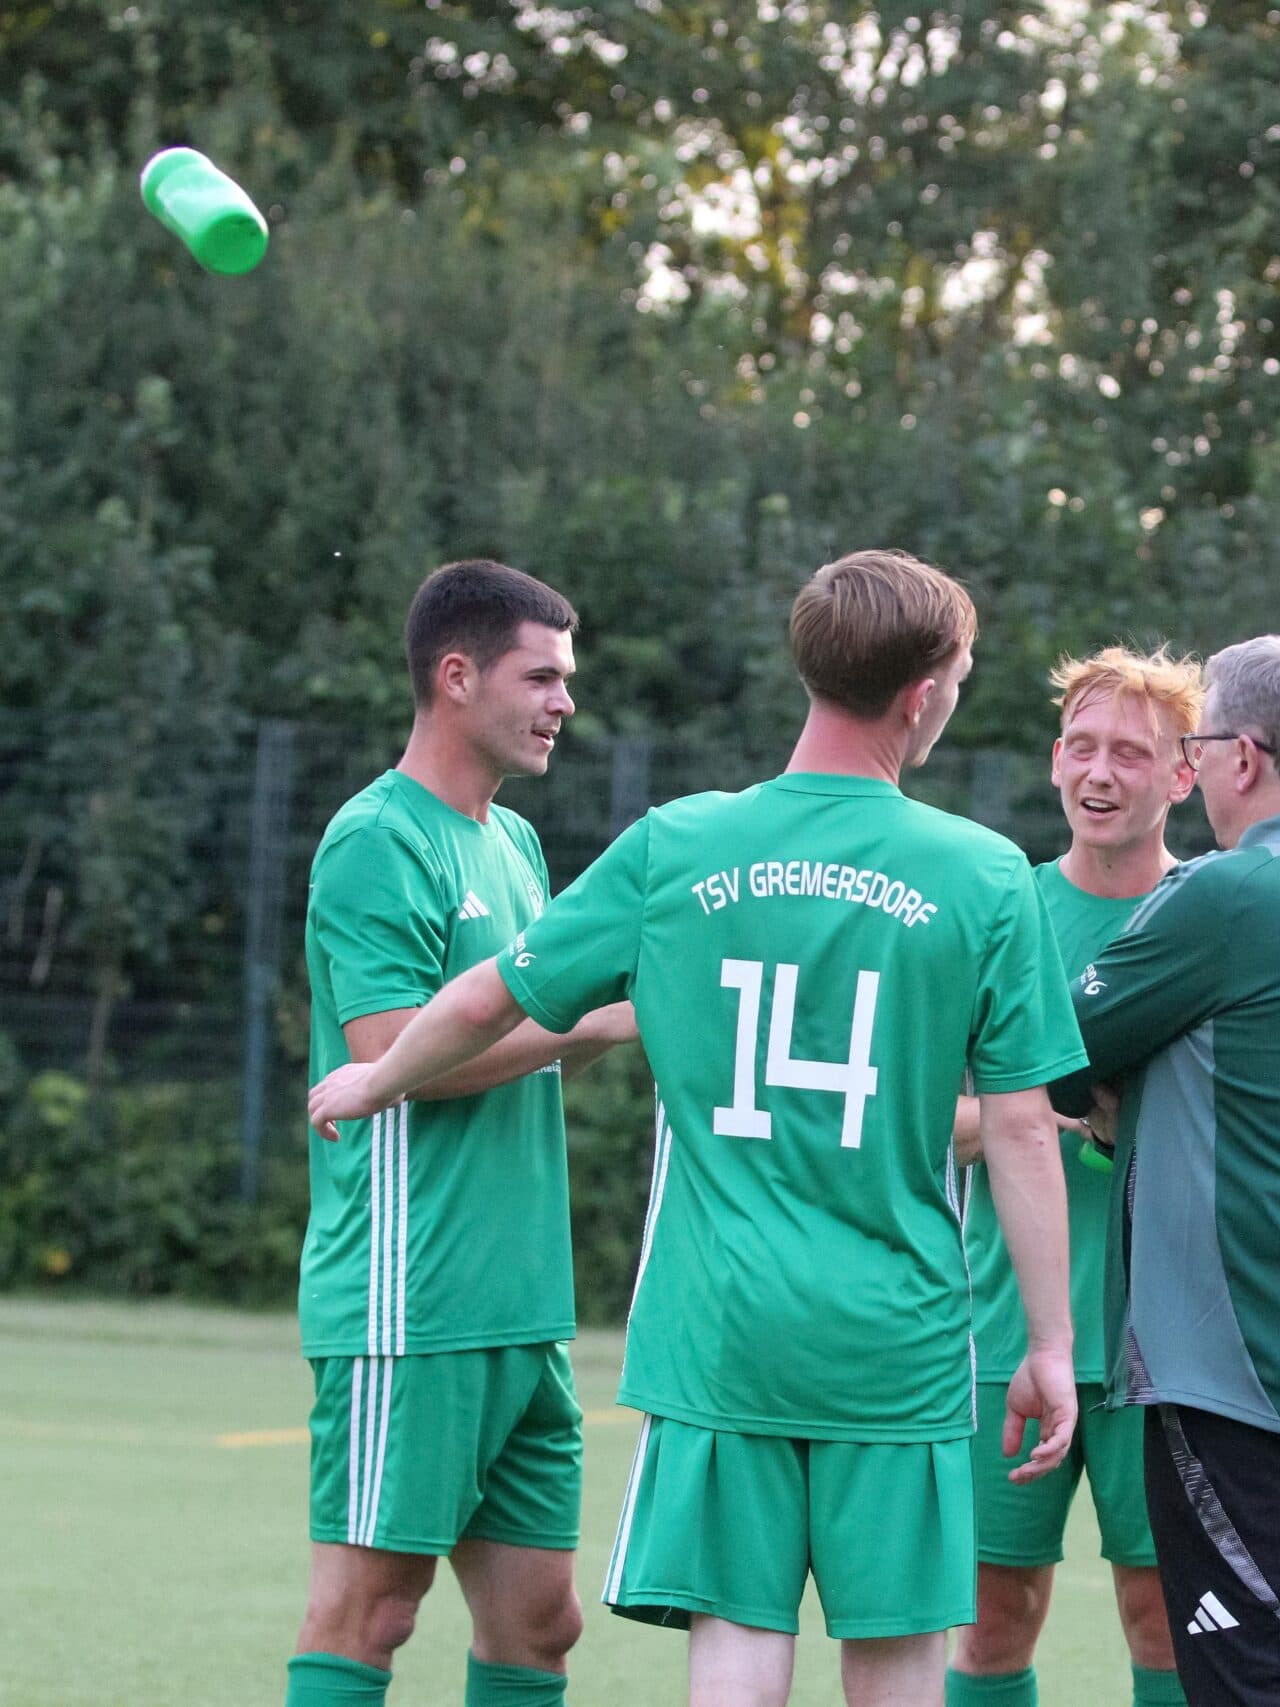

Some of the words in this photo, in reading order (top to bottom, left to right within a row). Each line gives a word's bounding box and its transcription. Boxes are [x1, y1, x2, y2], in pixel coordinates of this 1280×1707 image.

[691, 867, 739, 915] TSV
[749, 860, 938, 928] GREMERSDORF
[713, 958, 880, 1148] 14
